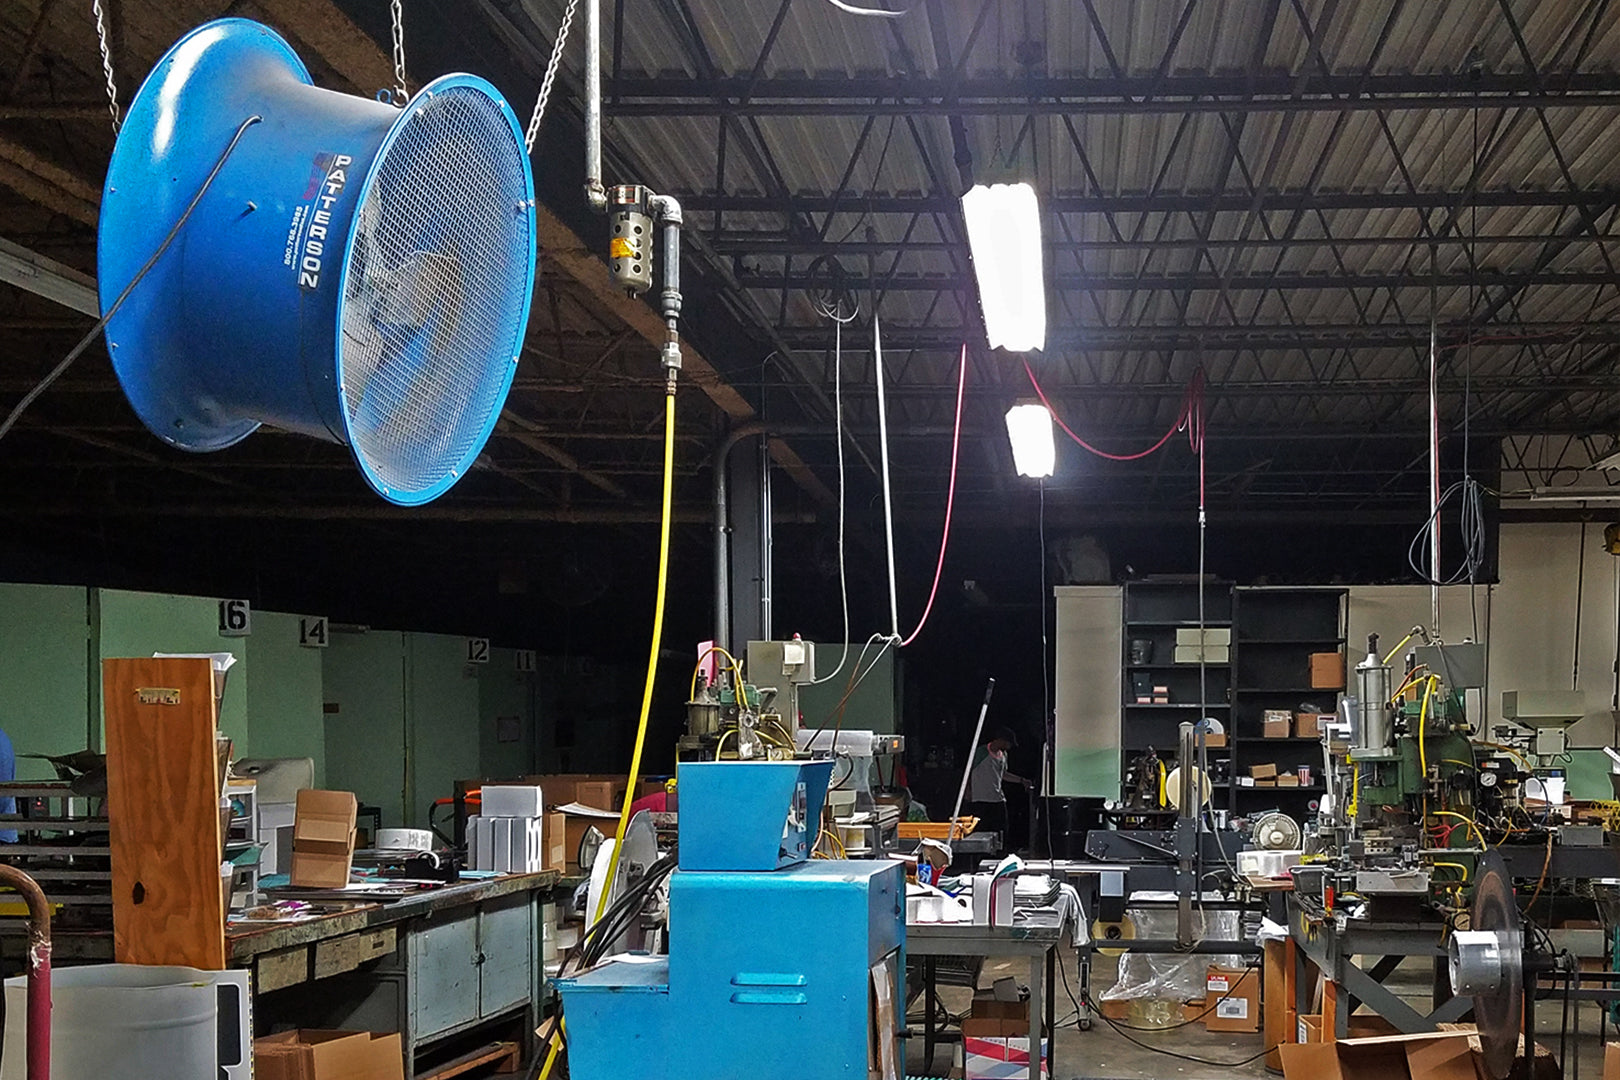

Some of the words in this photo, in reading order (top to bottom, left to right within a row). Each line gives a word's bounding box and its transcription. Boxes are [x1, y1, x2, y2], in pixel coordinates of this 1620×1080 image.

[300, 154, 352, 288] PATTERSON
[219, 600, 247, 630] 16
[300, 618, 325, 644] 14
[467, 640, 487, 661] 12
